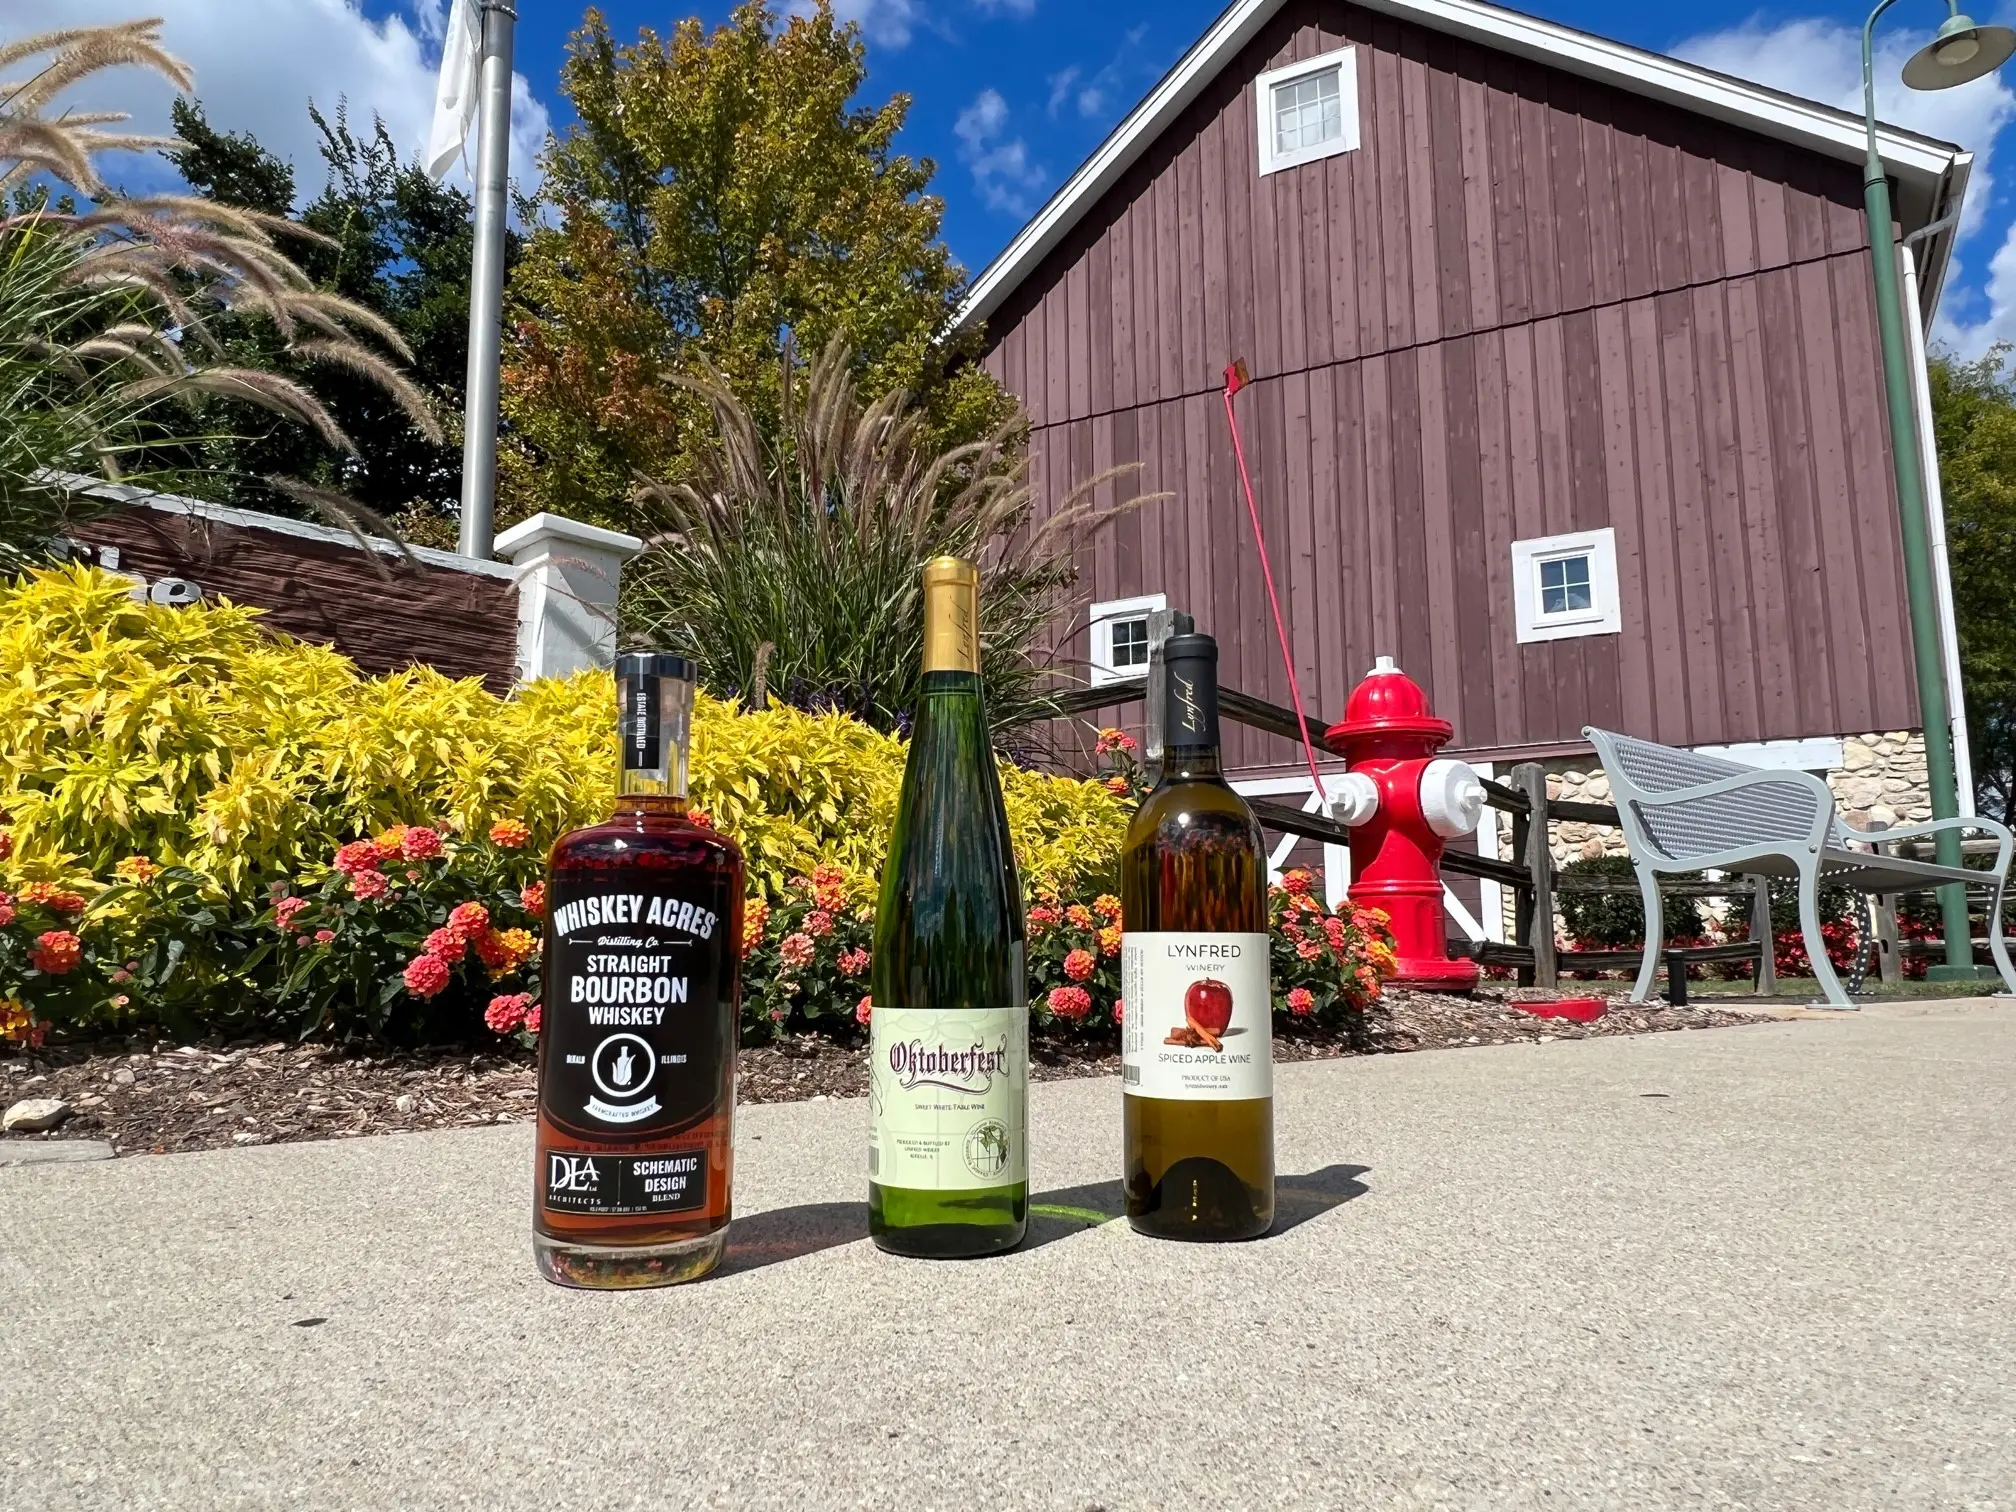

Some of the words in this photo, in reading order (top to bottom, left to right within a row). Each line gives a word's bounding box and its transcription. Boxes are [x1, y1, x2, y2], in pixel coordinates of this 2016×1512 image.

[636, 692, 647, 715] ESTATE
[1174, 671, 1206, 733] Lynfred
[636, 716, 647, 749] DISTILLED
[553, 894, 644, 937] WHISKEY
[646, 896, 716, 940] ACRES
[597, 936, 643, 948] Distilling
[645, 936, 660, 949] Co.
[1167, 944, 1241, 958] LYNFRED
[586, 954, 672, 974] STRAIGHT
[1186, 964, 1226, 972] WINERY
[570, 975, 688, 1004] BOURBON
[588, 1006, 665, 1026] WHISKEY
[889, 1033, 1011, 1095] Oktoberfest
[1158, 1053, 1193, 1064] SPICED
[1194, 1054, 1227, 1064] APPLE
[1228, 1054, 1252, 1064] WINE
[549, 1155, 601, 1192] DLA
[633, 1157, 698, 1176] SCHEMATIC
[644, 1176, 687, 1193] DESIGN
[548, 1194, 602, 1205] ARCHITECTS
[652, 1192, 681, 1203] BLEND
